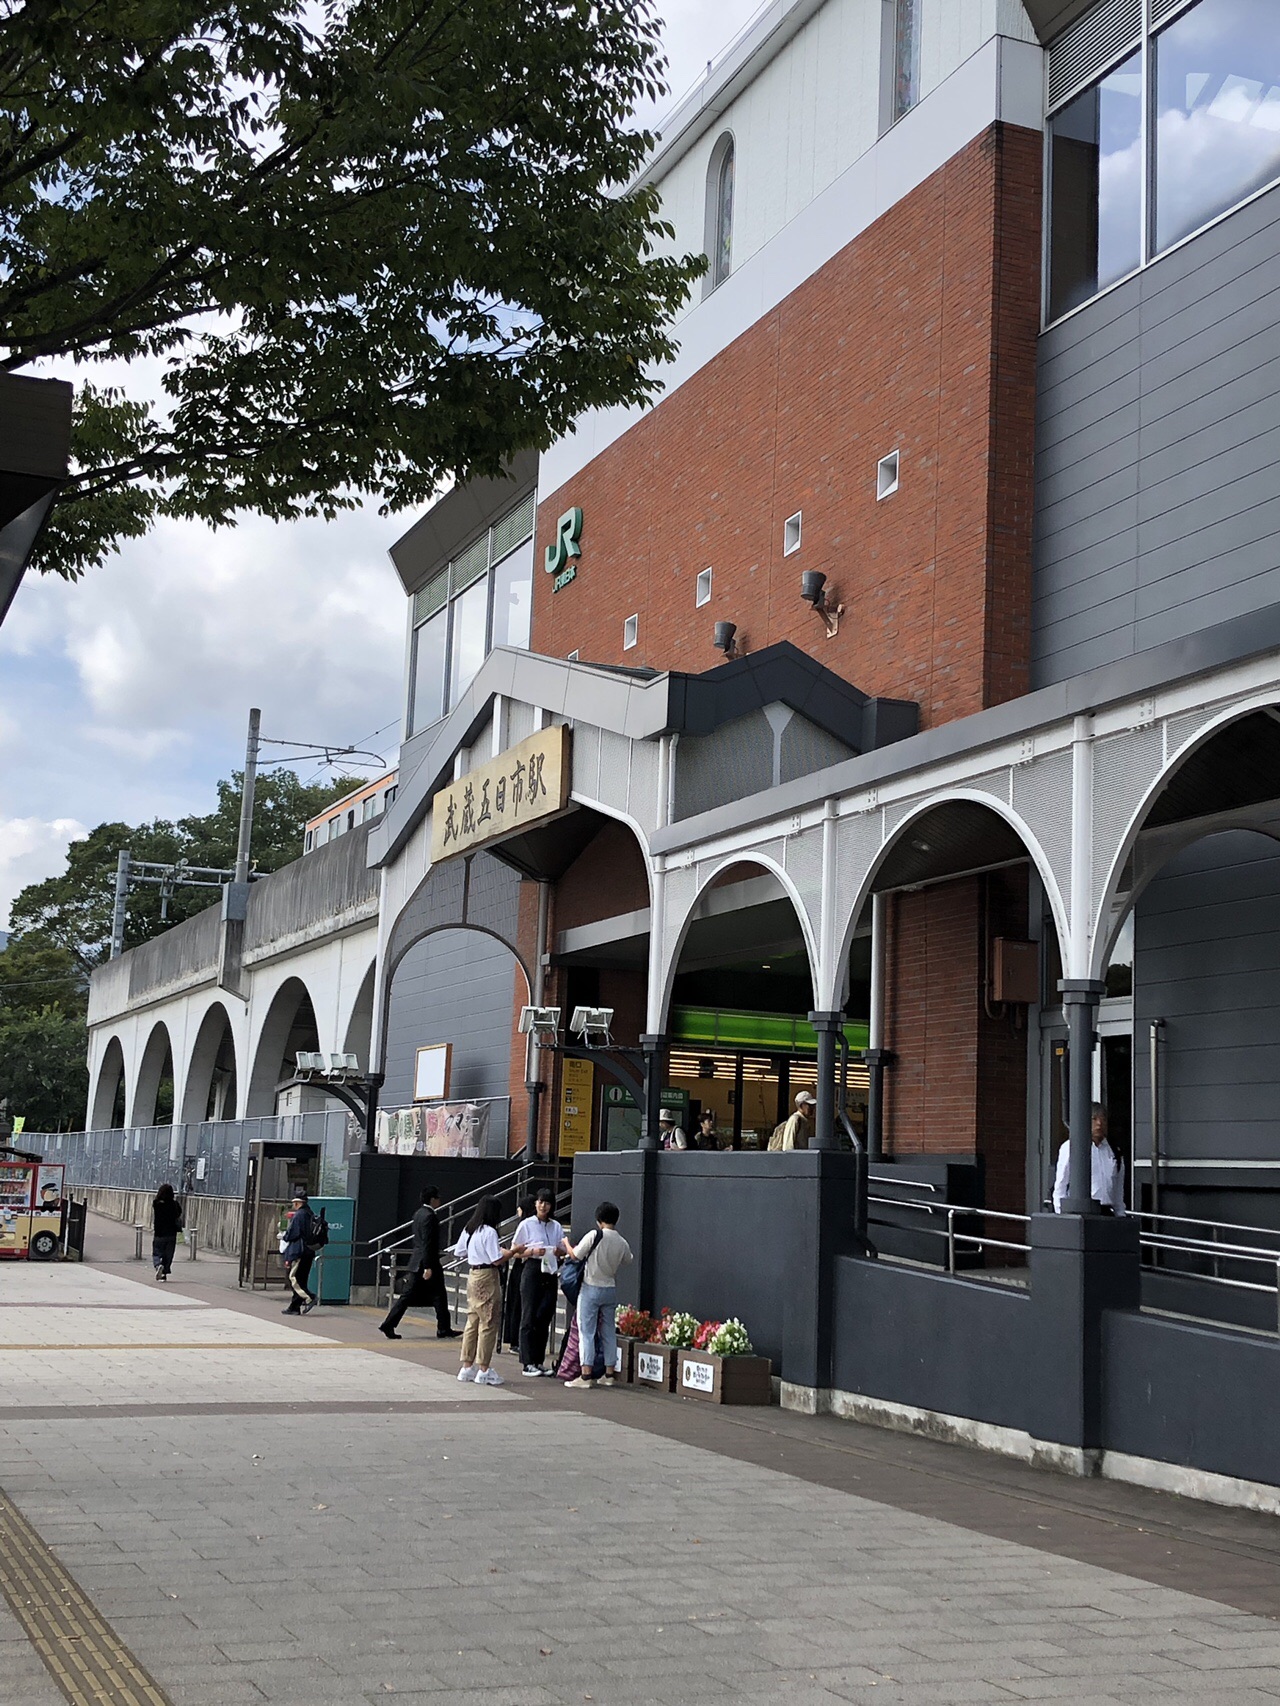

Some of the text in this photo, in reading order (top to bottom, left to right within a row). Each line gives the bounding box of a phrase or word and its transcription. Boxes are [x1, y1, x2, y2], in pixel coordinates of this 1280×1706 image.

[545, 507, 583, 574] JR
[443, 752, 547, 846] 武蔵五日市駅
